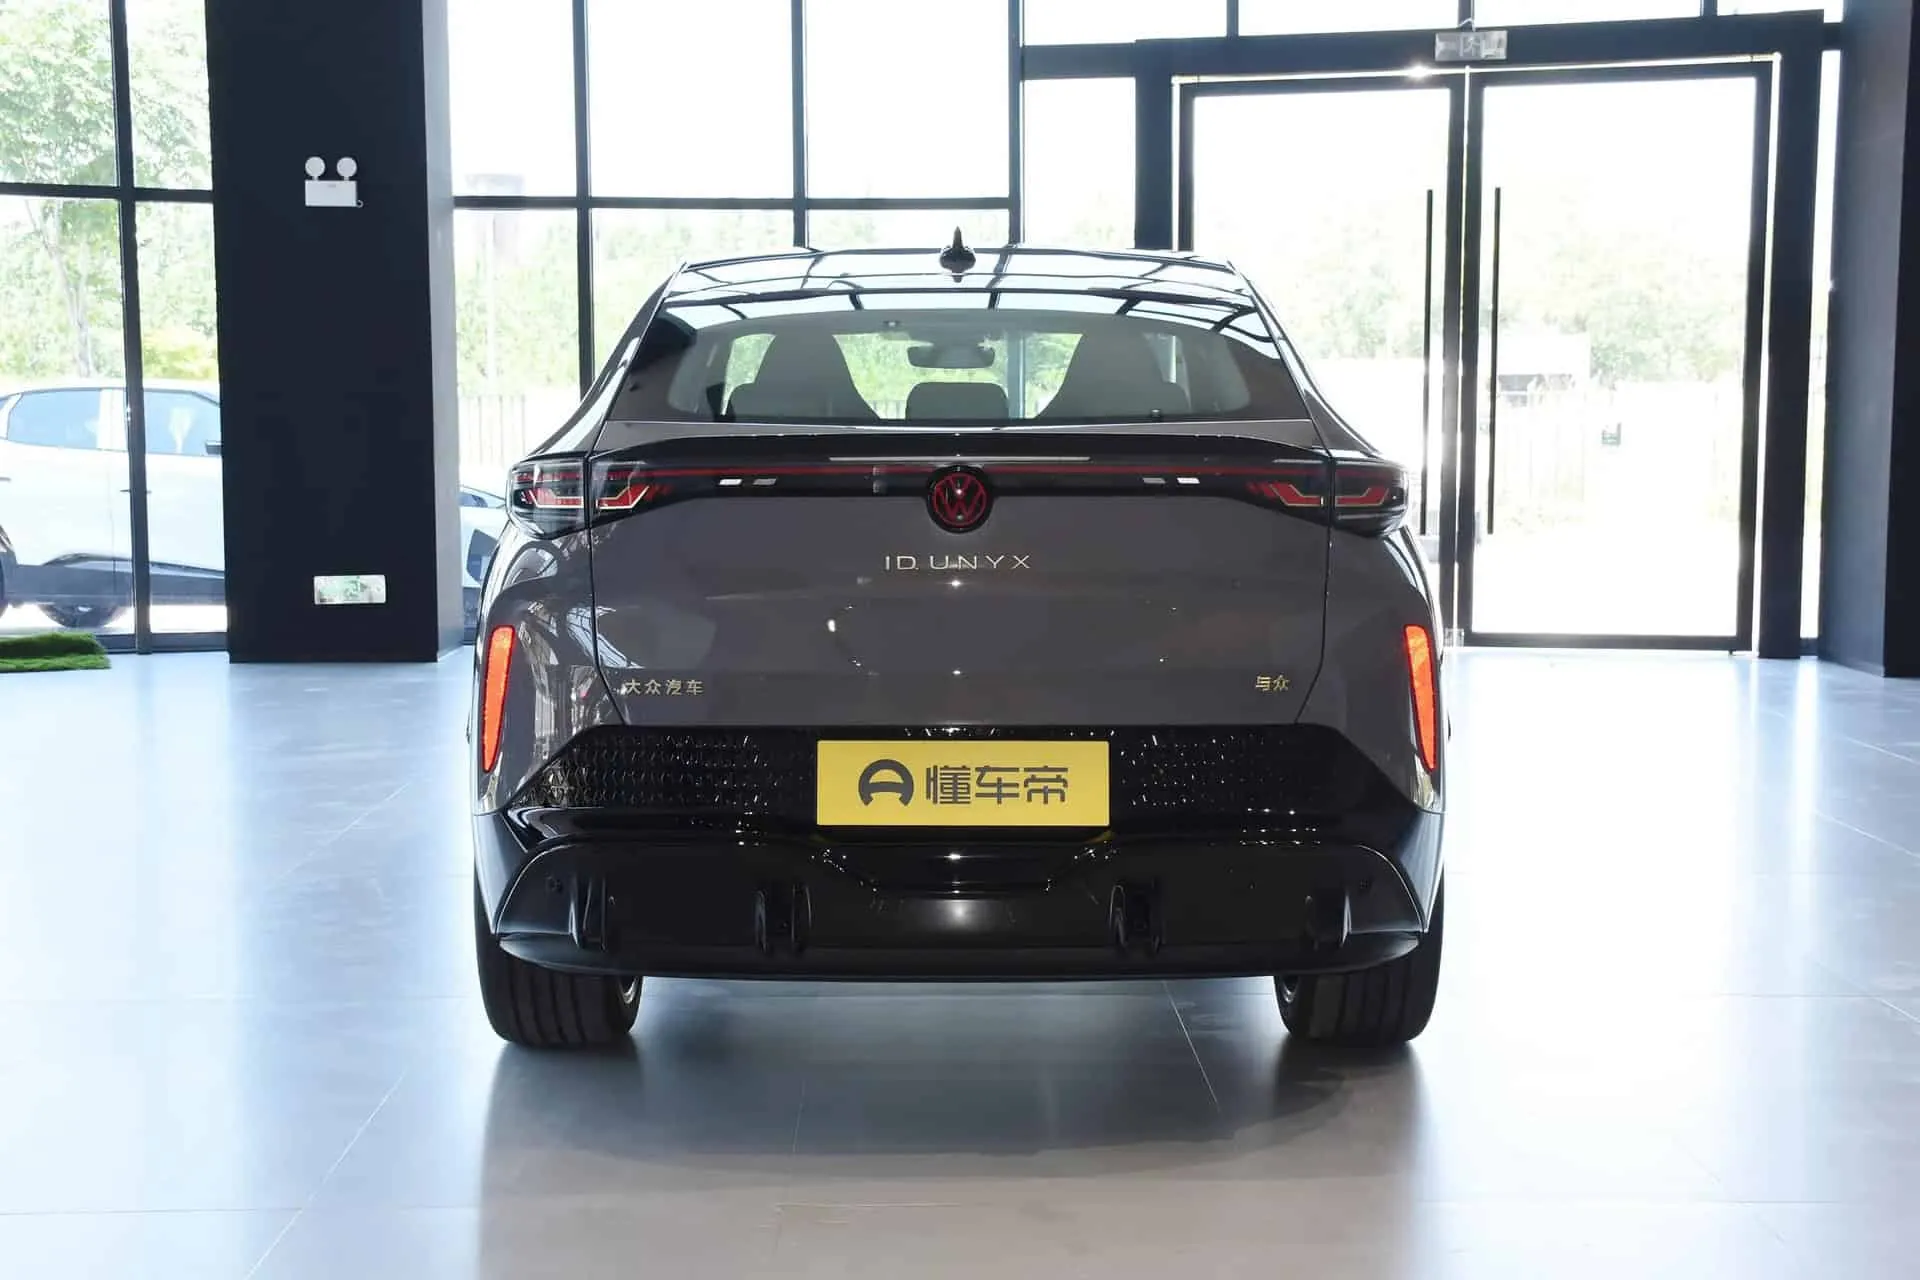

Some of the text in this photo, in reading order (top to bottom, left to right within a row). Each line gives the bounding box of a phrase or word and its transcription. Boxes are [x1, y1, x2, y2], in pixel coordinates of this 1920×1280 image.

[929, 555, 1030, 570] UNYX
[625, 678, 704, 696] 大众汽车
[1255, 674, 1290, 692] 与众
[925, 765, 1069, 805] 懂车帝
